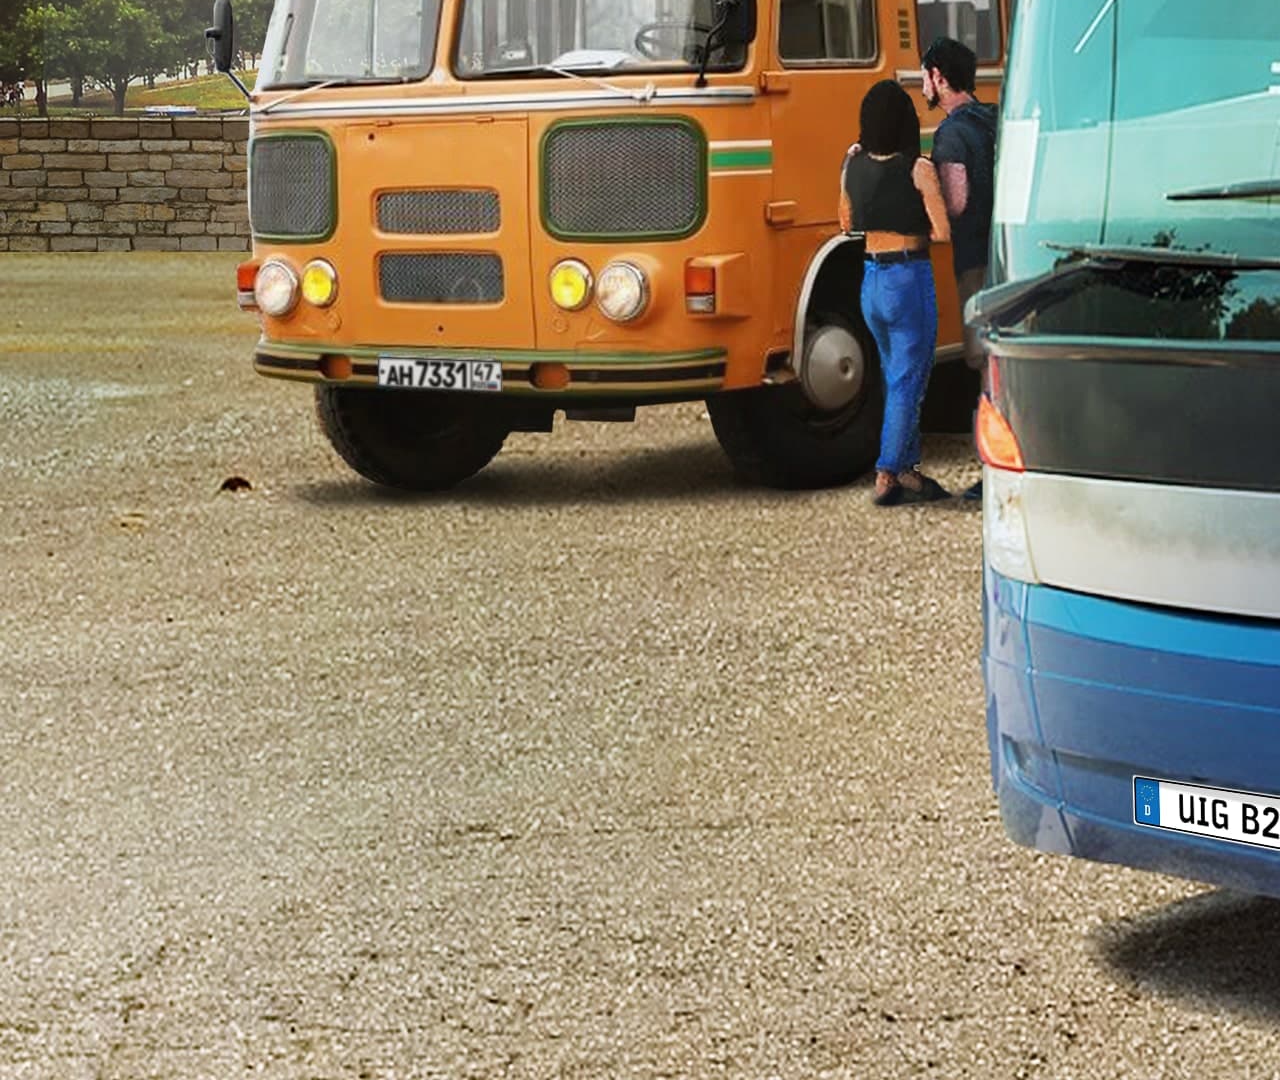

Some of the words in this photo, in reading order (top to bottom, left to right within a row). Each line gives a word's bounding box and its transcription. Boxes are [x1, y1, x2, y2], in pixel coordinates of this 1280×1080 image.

[474, 363, 494, 382] 47
[1144, 804, 1151, 816] D
[1178, 794, 1229, 831] UIG
